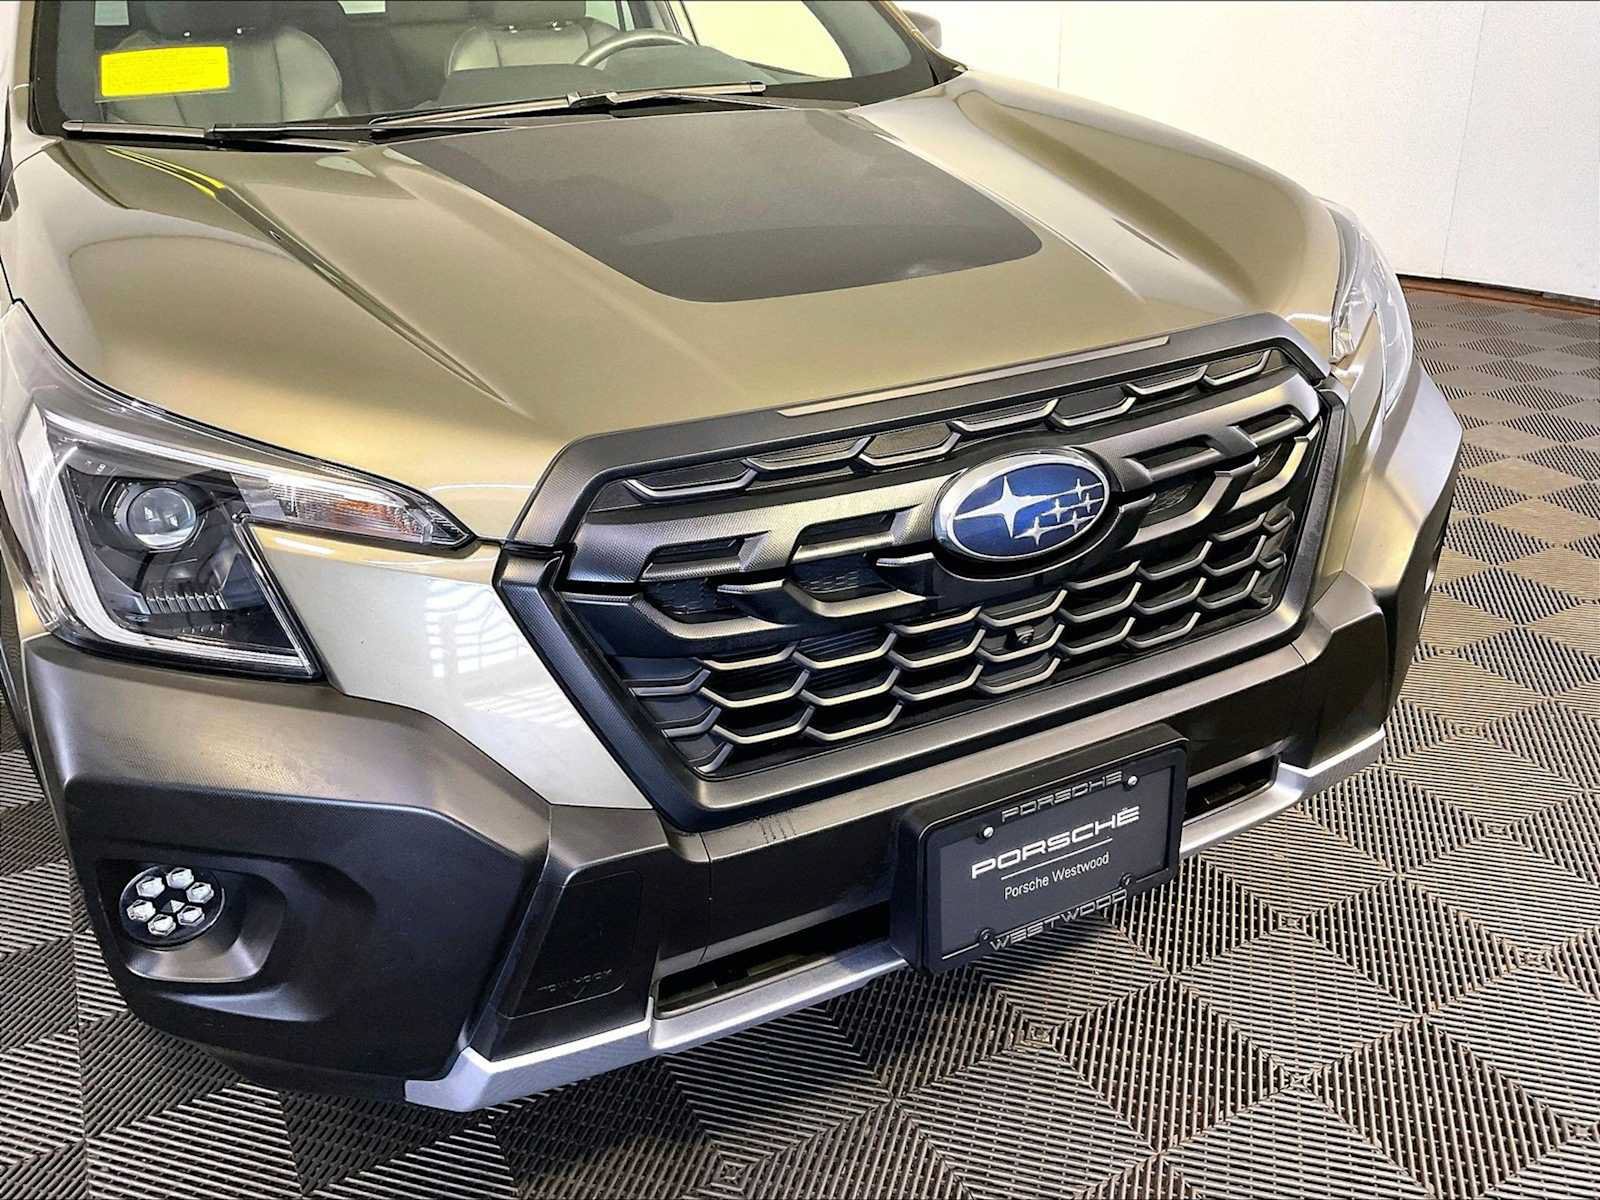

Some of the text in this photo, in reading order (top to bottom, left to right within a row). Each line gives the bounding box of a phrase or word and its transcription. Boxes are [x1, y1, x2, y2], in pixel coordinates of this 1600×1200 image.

[1001, 770, 1123, 822] PORSCHE
[971, 806, 1140, 880] PORSCHE
[1004, 851, 1110, 900] Porsche Westwood
[990, 888, 1128, 951] WESTWOOD
